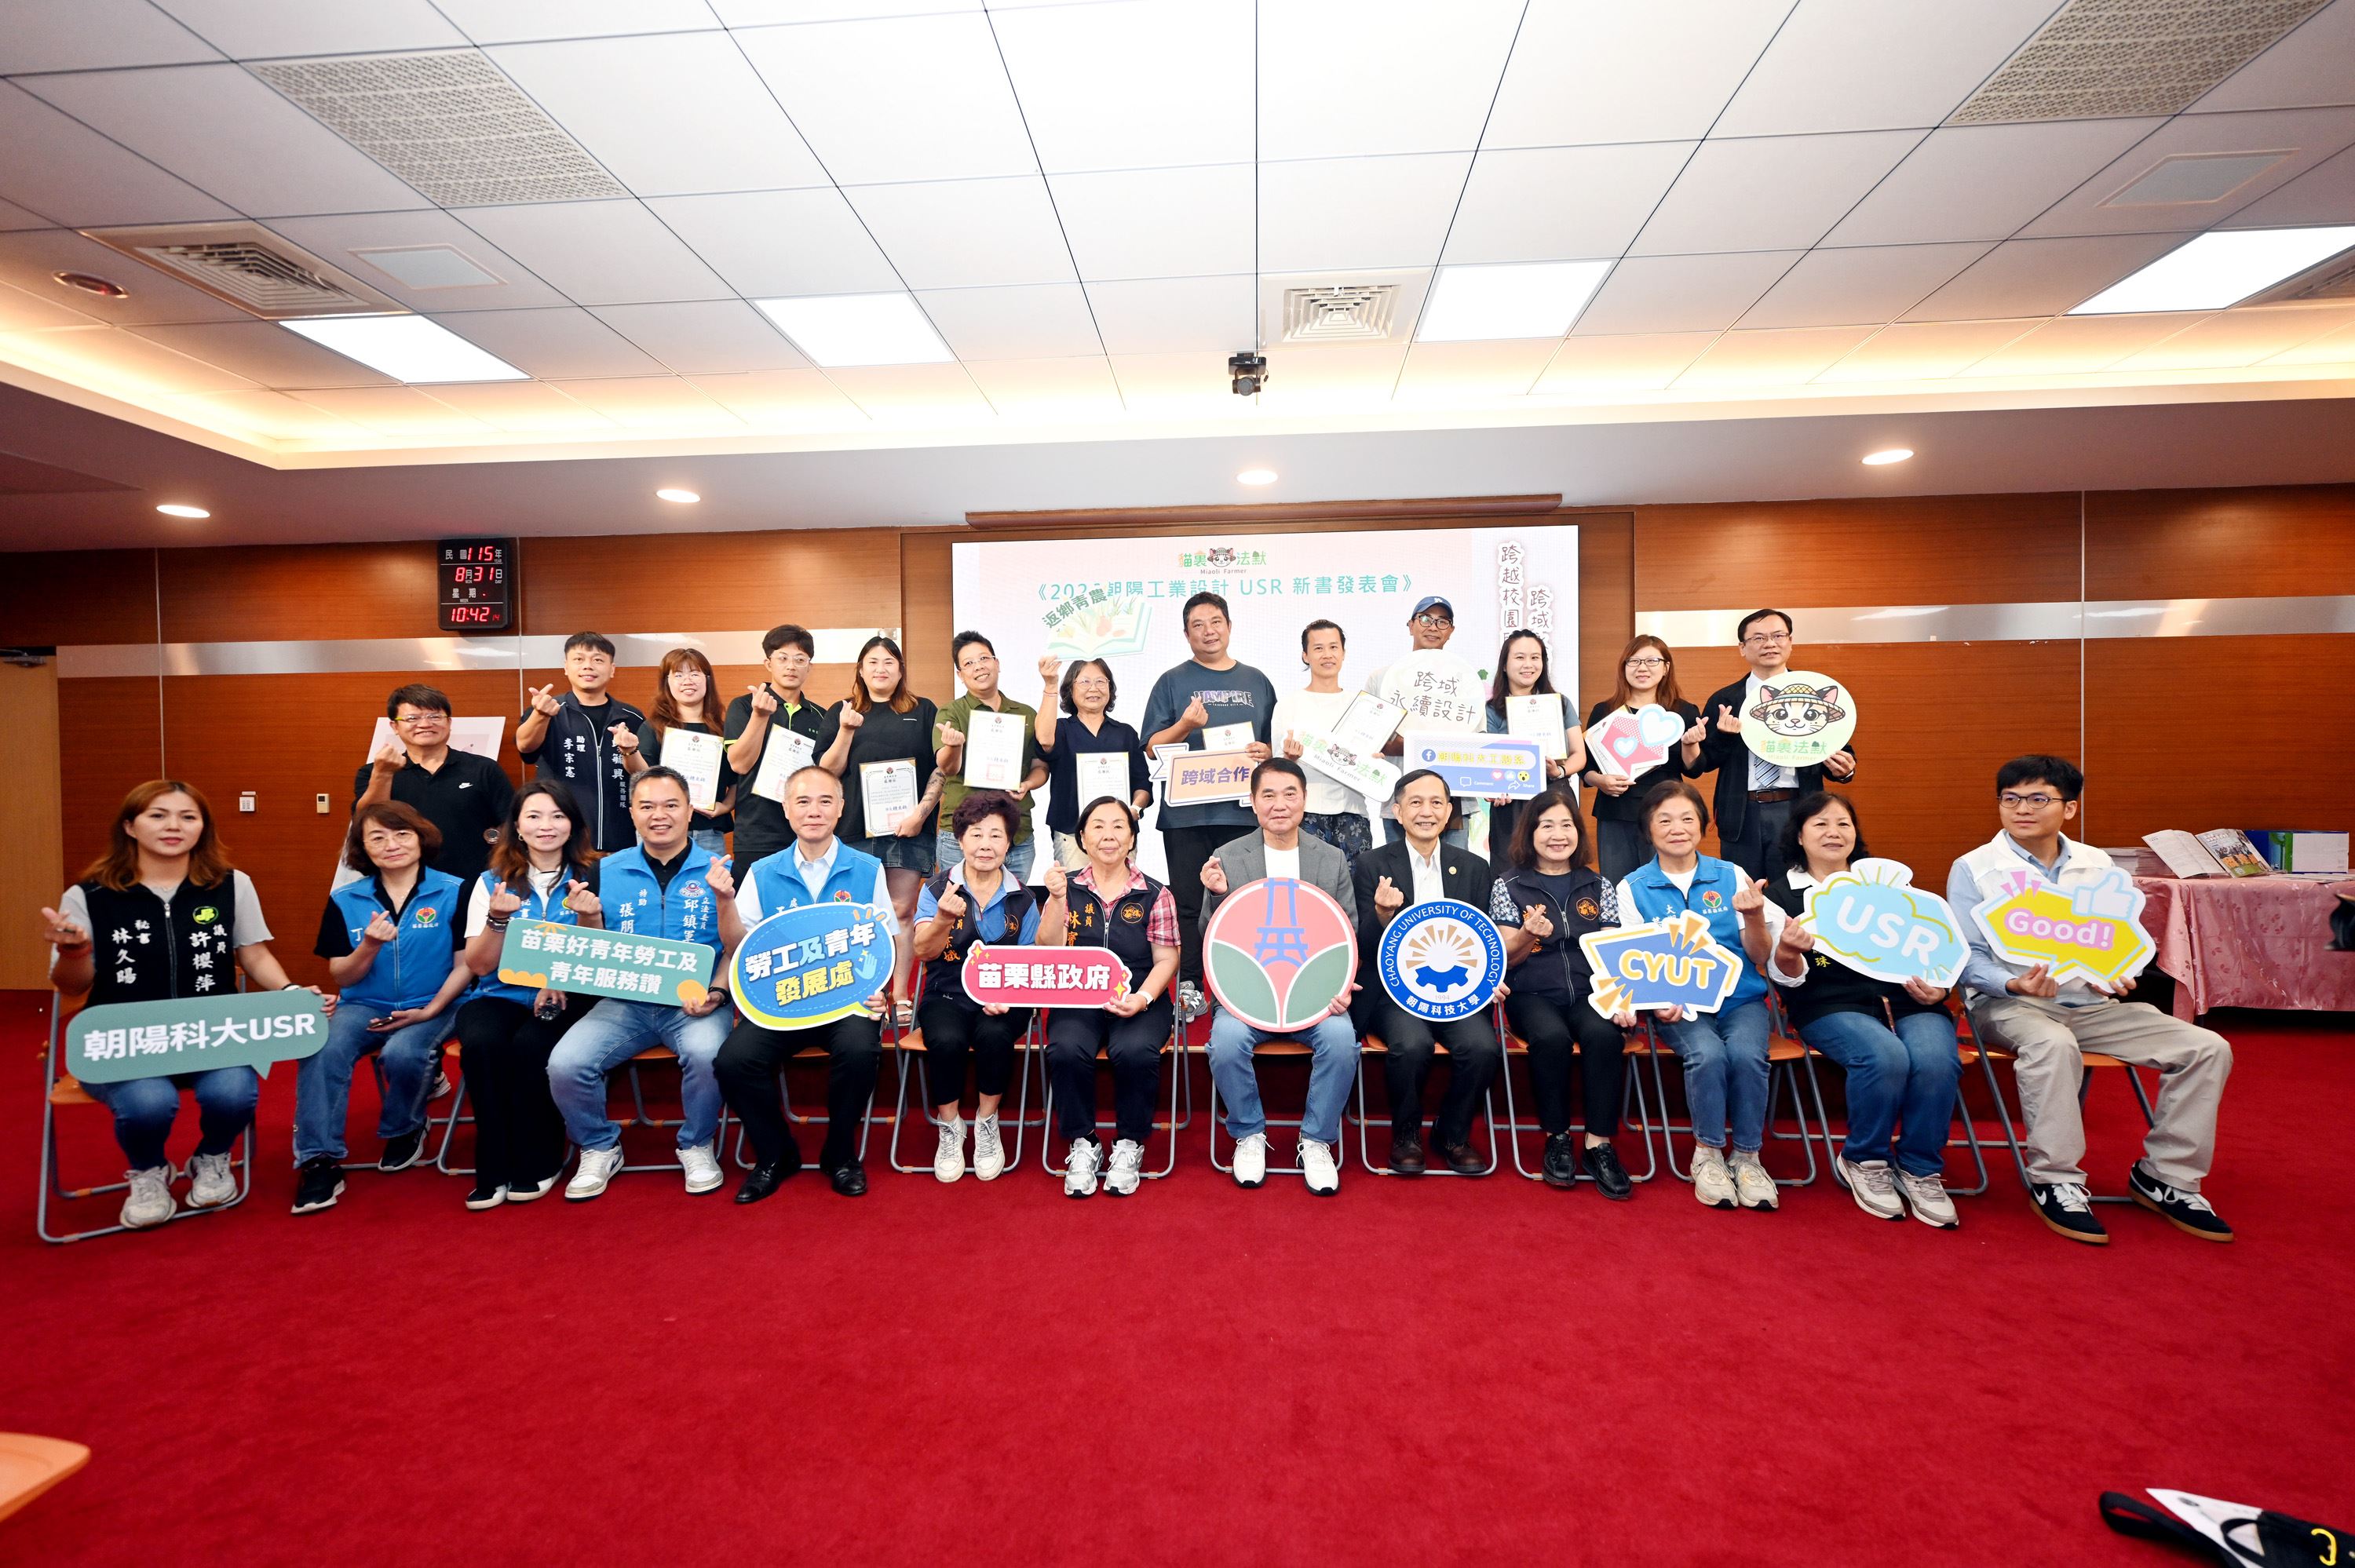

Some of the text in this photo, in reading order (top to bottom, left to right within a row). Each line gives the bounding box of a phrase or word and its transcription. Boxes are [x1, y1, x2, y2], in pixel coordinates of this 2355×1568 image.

[495, 549, 502, 559] 年
[455, 567, 465, 582] 8
[466, 569, 473, 579] 月
[1240, 578, 1282, 595] USR
[451, 607, 490, 622] 10:42
[1042, 588, 1108, 629] 返鄉青農
[1414, 672, 1459, 697] 跨域
[1390, 690, 1476, 724] 永續設計
[576, 736, 586, 752] 助理
[1181, 766, 1250, 786] 跨域合作
[1338, 767, 1361, 782] Farmer
[699, 896, 710, 930] 立法委員
[1084, 903, 1095, 928] 議員
[1837, 895, 1940, 967] USR
[2007, 910, 2112, 948] Good!
[520, 928, 698, 973] 苗栗好青年勞工及
[745, 921, 876, 983] 勞工及青年
[1386, 930, 1402, 987] CHAOYANG
[1399, 905, 1459, 932] UNIVERSITY
[1459, 910, 1476, 921] OF
[1474, 917, 1500, 986] TECHNOLOGY
[776, 960, 855, 1007] 發展處
[977, 962, 1111, 990] 苗栗縣政府
[1619, 949, 1717, 989] CYUT
[1405, 994, 1481, 1016] 朝陽科技大學
[83, 1013, 316, 1061] 朝陽科大USR
